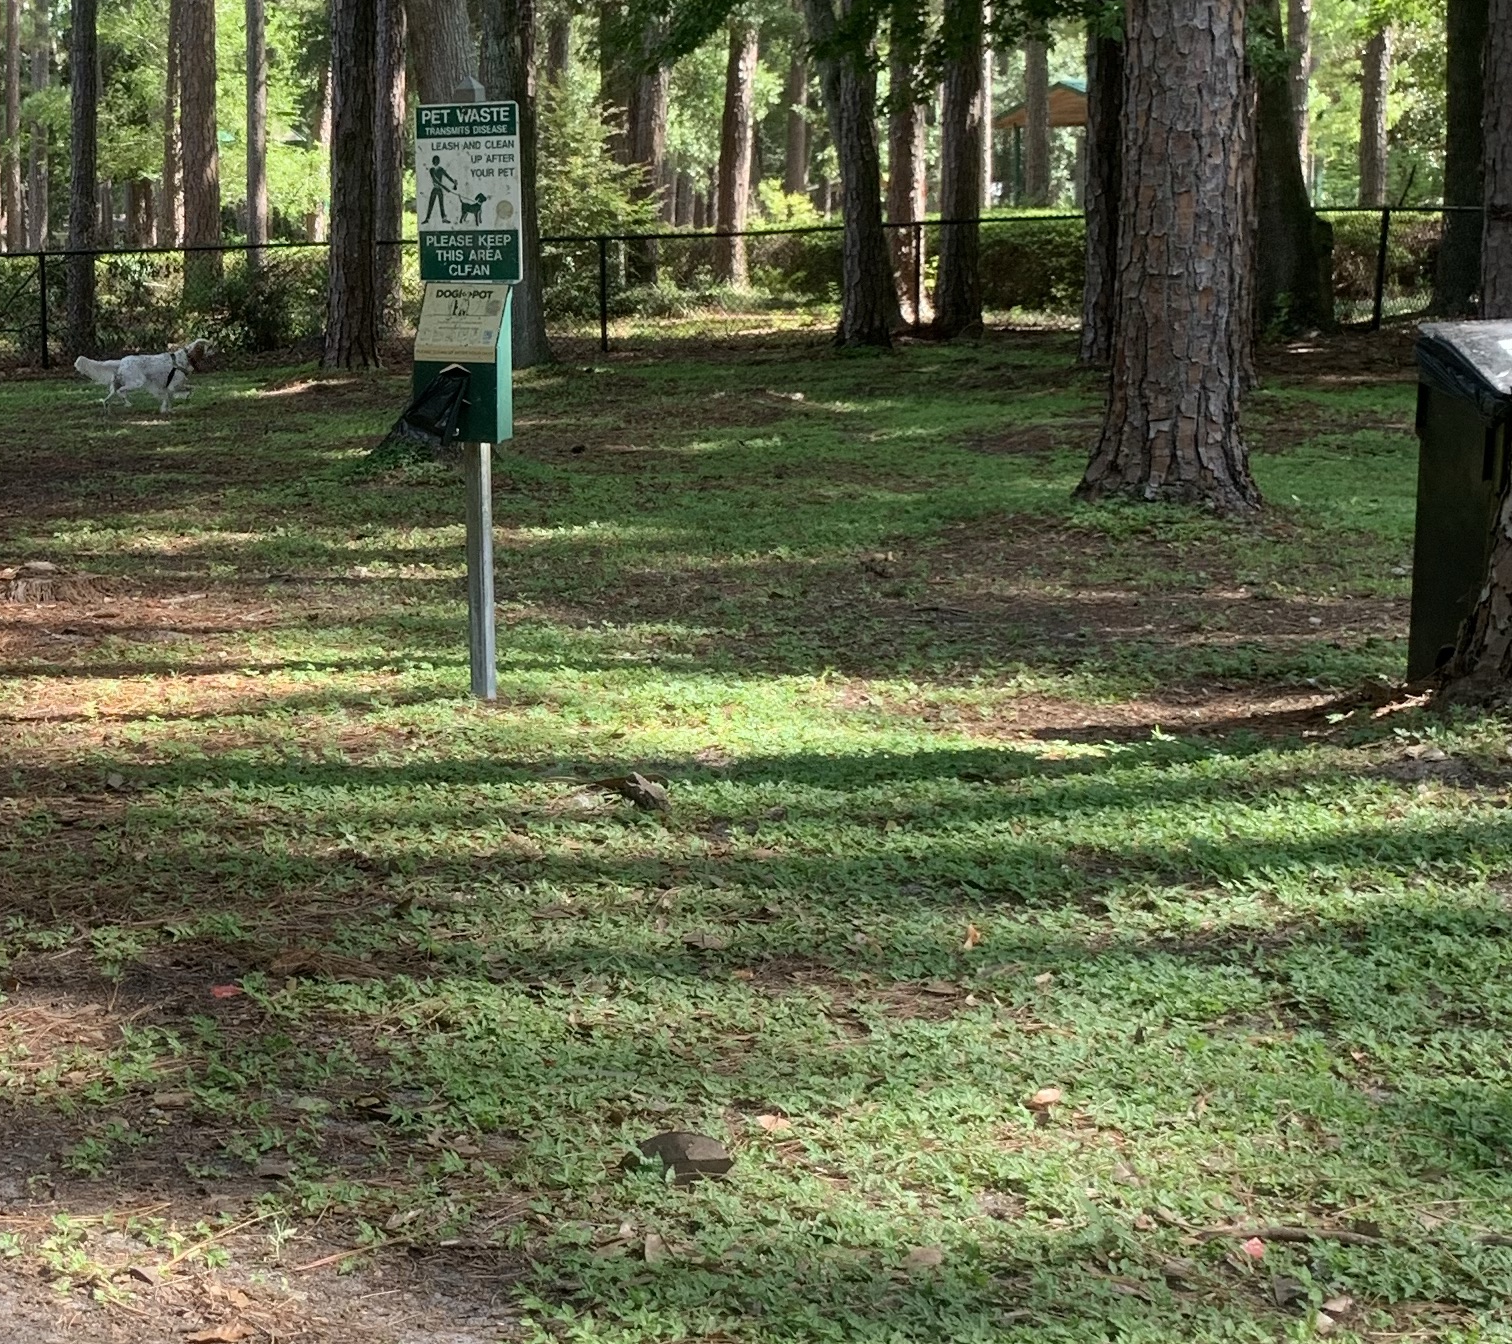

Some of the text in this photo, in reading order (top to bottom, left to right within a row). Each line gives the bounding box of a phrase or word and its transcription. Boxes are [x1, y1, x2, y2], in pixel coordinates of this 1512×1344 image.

[421, 107, 510, 124] PET WASTE
[425, 125, 507, 136] TRANSMITS DISEASE
[431, 140, 515, 151] LEASH AND CLEAN
[470, 154, 515, 164] UP AFTER
[470, 168, 515, 178] YOUR PET
[426, 234, 512, 247] PLEASE KEEP
[435, 249, 503, 262] THIS AREA
